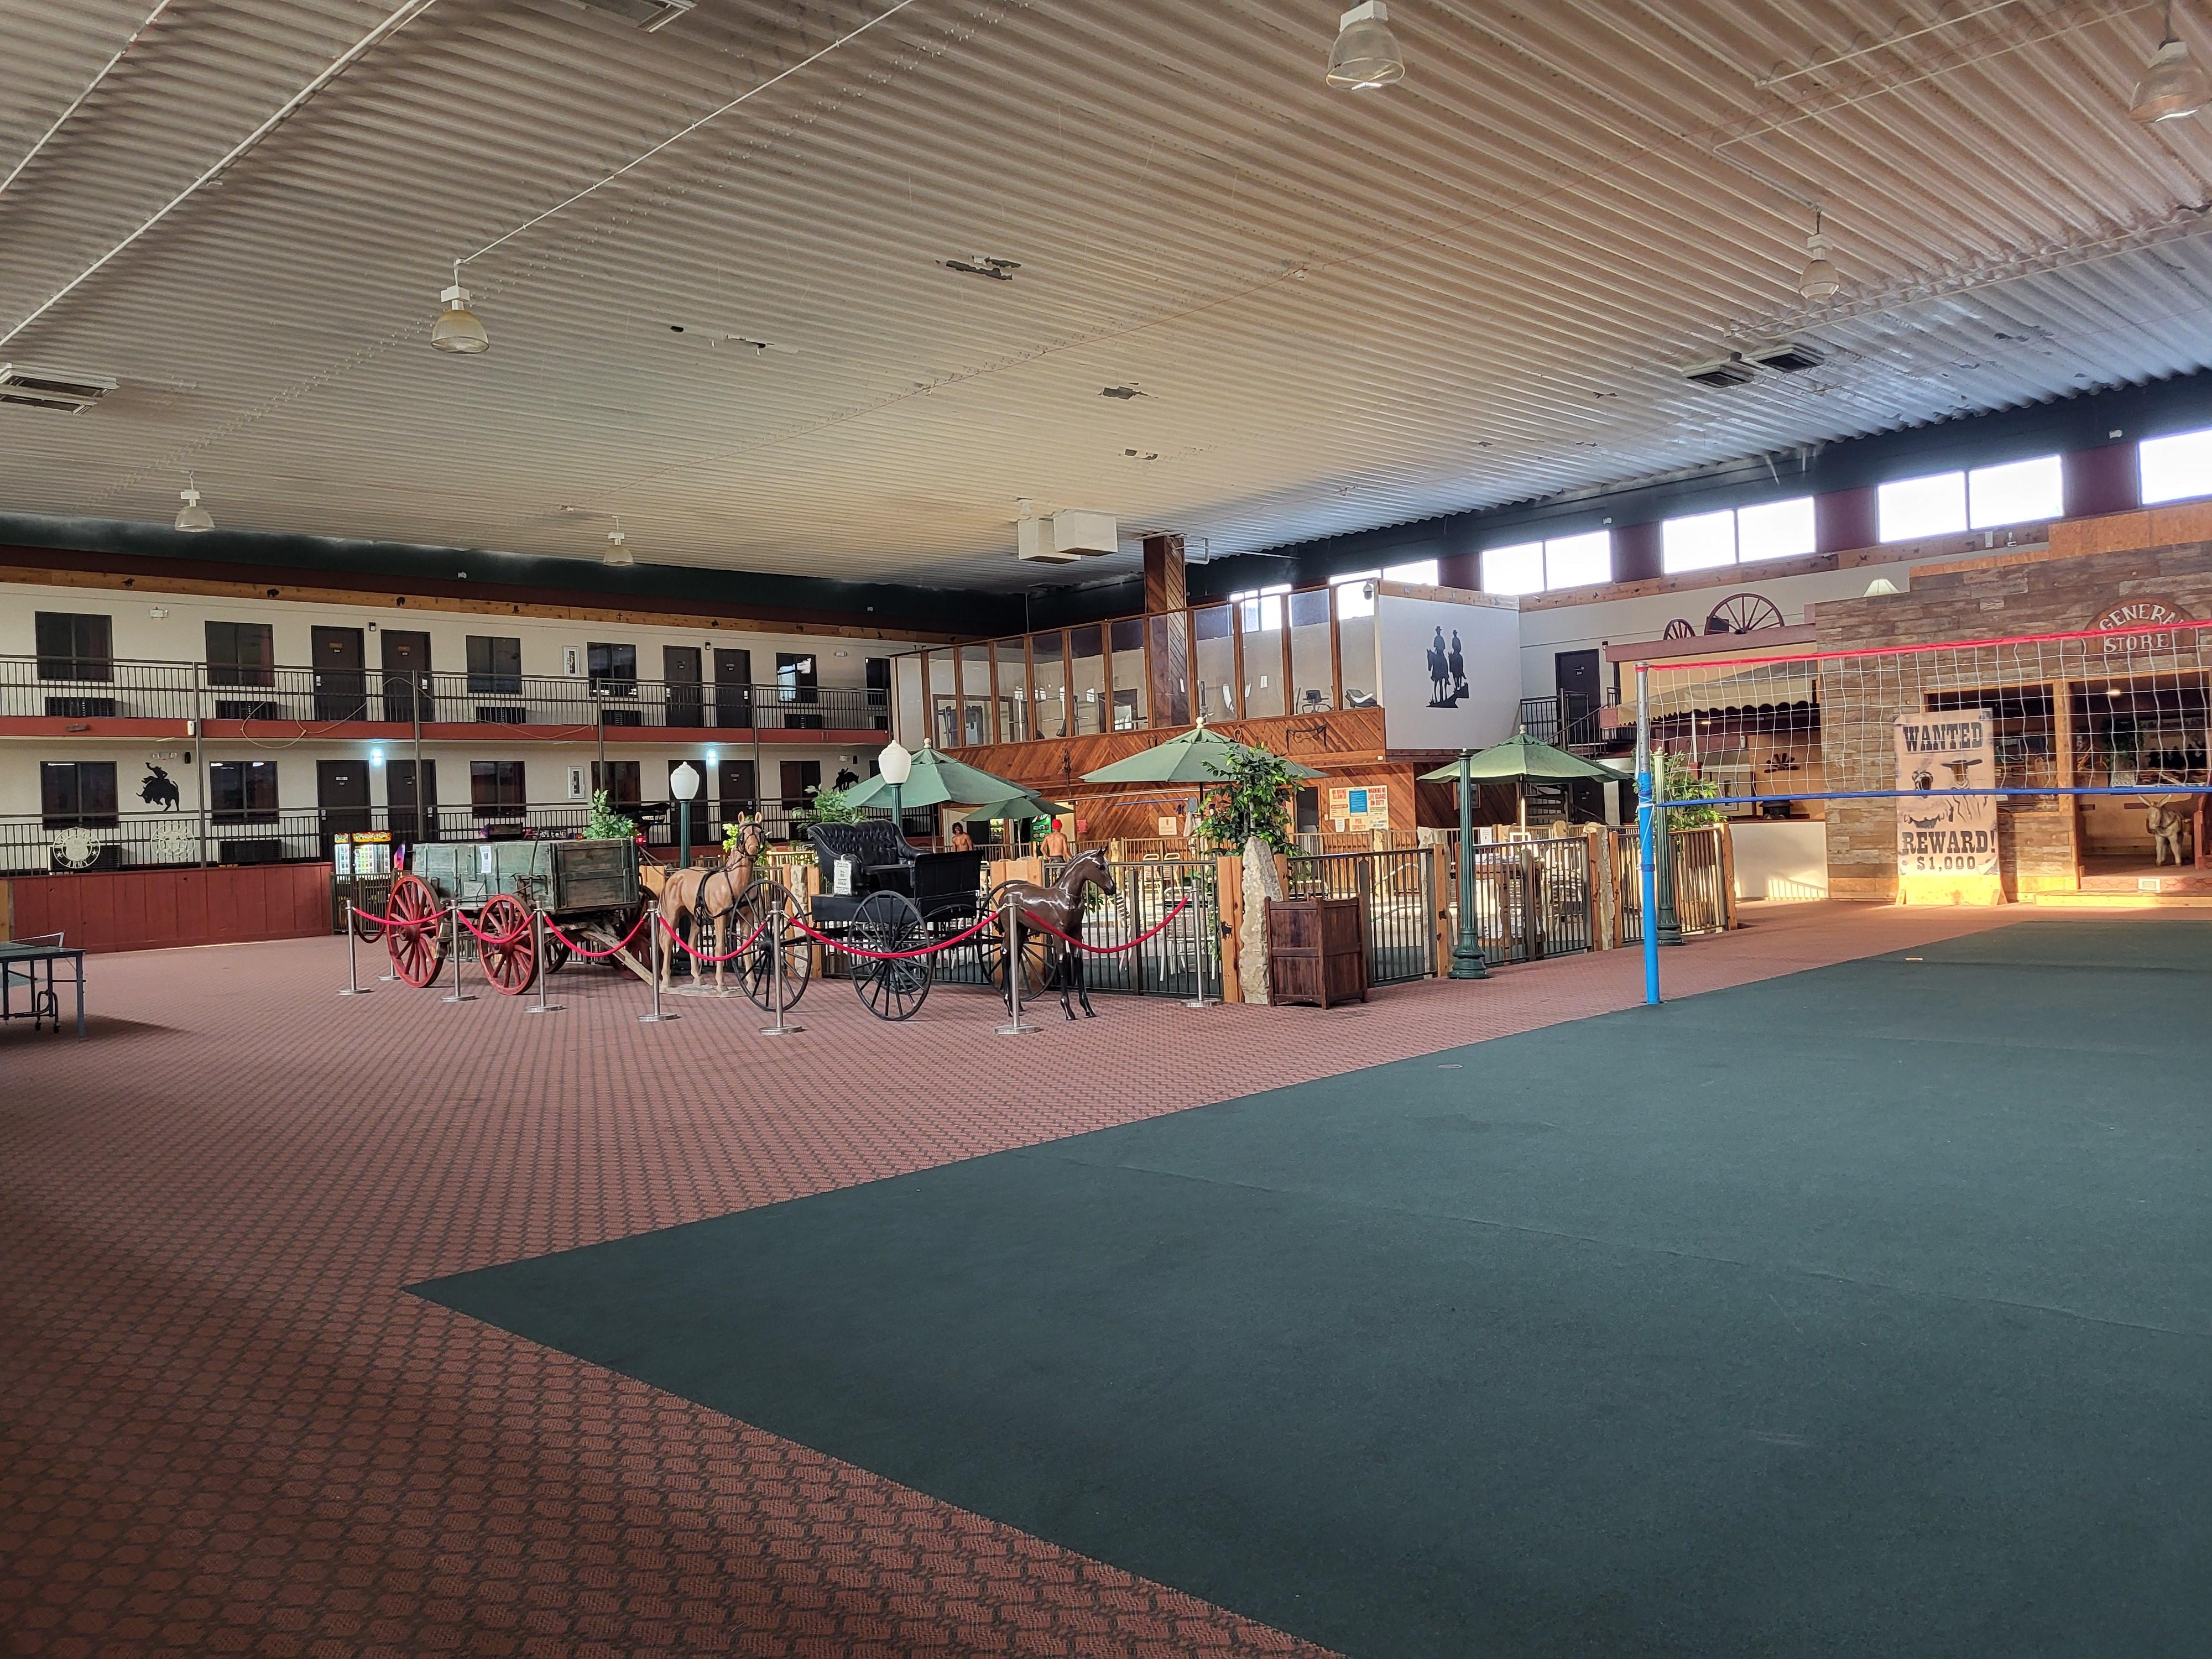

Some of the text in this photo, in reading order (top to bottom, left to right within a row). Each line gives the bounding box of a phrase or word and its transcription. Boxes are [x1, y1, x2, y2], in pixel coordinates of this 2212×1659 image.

[2099, 603, 2193, 632] GENERA
[2105, 634, 2168, 653] STORE
[1903, 722, 1983, 752] WANTED
[1902, 831, 1995, 854] REWARD!
[66, 859, 88, 868] ARMY
[1917, 856, 1975, 872] $1,000
